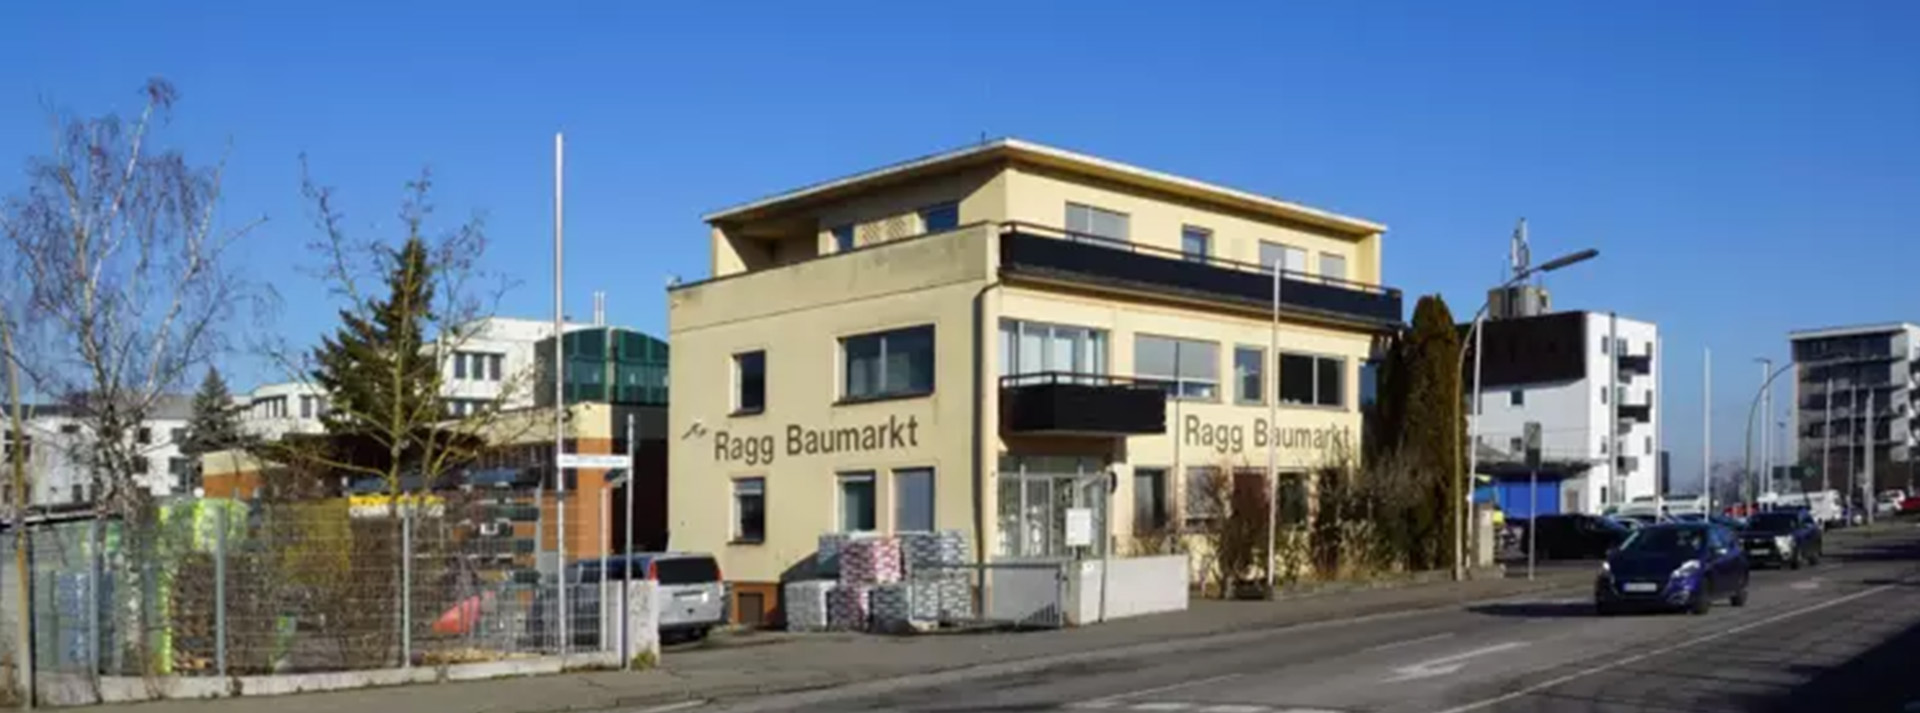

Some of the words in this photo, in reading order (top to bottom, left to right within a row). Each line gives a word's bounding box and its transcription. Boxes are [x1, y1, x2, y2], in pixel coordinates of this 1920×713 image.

[714, 431, 774, 465] Ragg
[786, 414, 918, 456] Baumarkt
[1185, 414, 1244, 453] Ragg
[1254, 418, 1350, 449] Baumarkt
